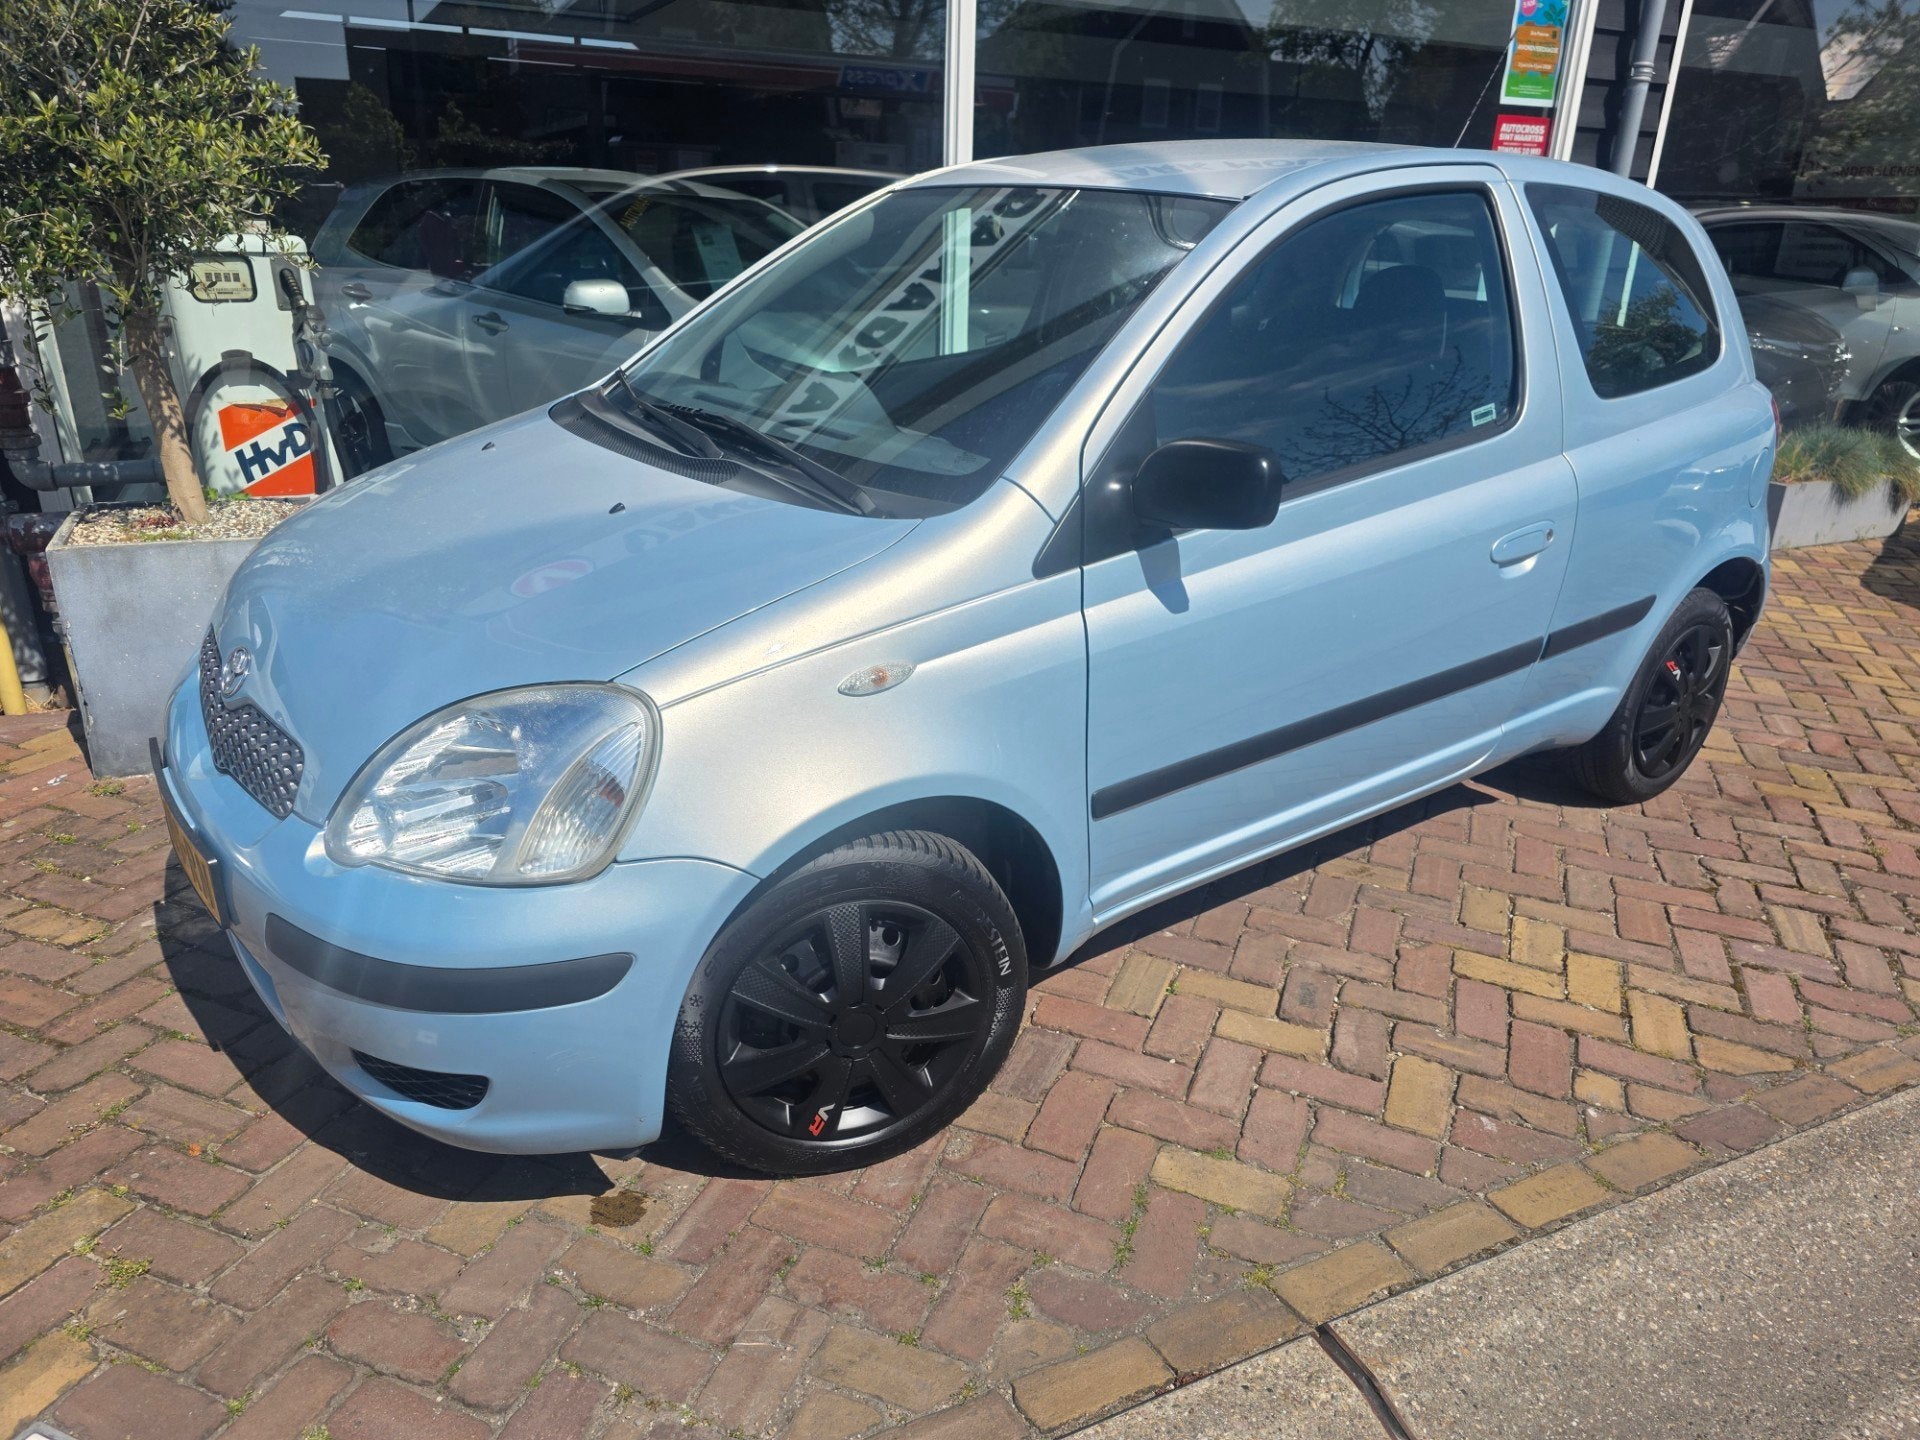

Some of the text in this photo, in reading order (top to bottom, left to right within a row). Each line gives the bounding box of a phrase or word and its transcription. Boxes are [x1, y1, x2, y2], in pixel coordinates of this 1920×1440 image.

[1500, 123, 1545, 134] AUTOCROSS
[1499, 133, 1544, 142] SINT MAARTEN
[808, 1102, 836, 1137] VR
